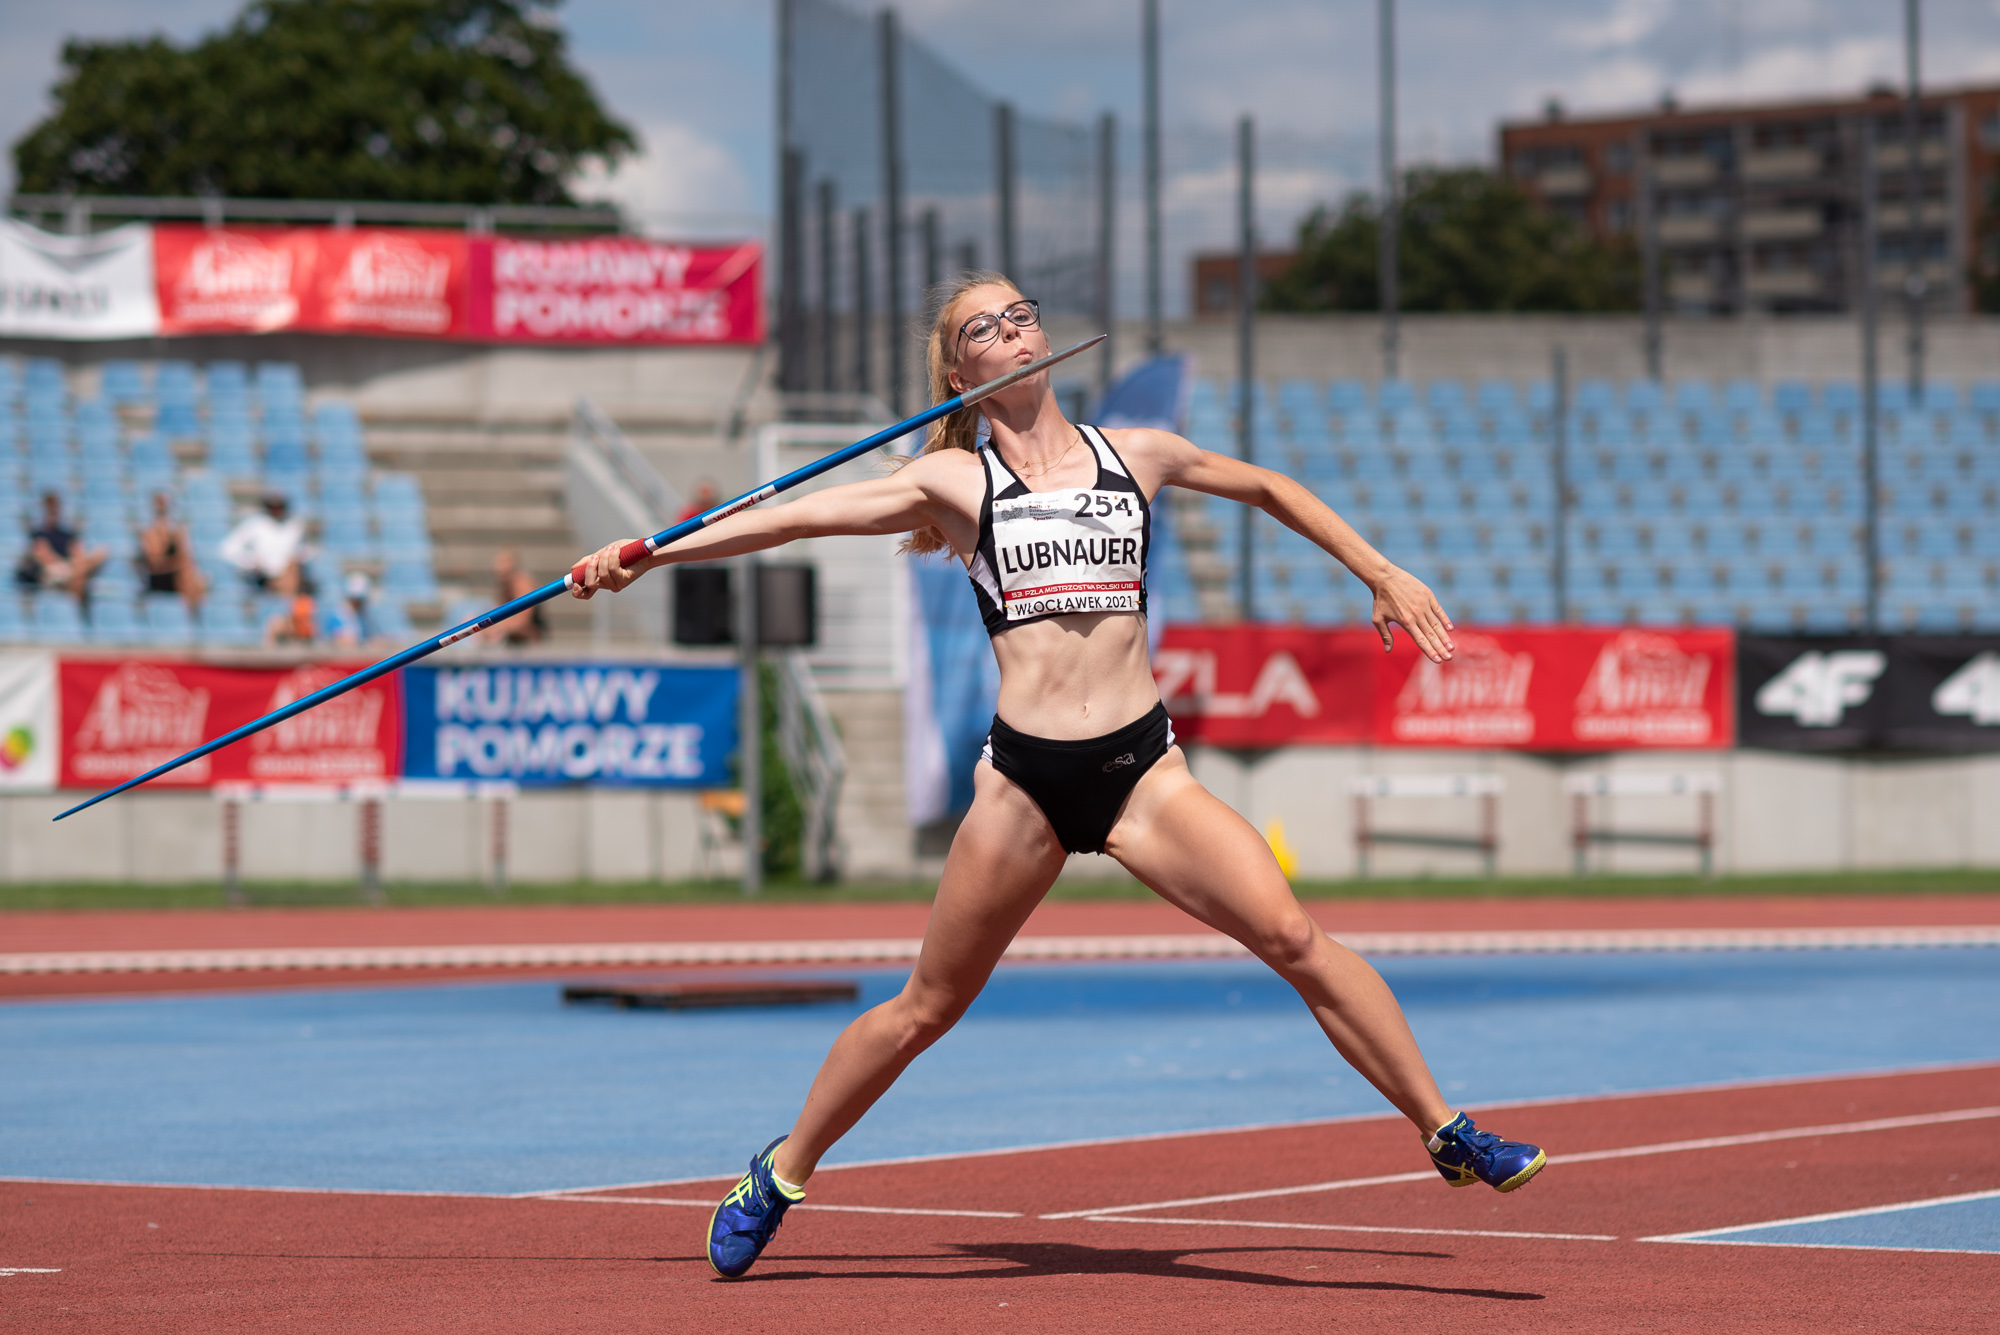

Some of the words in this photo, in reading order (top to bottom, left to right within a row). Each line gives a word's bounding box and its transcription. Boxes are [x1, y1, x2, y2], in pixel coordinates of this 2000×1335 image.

[493, 237, 693, 287] KUJAWY
[493, 288, 730, 337] POMORZE
[1074, 493, 1132, 517] 254
[1002, 538, 1137, 574] LUBNAUER
[1015, 596, 1102, 616] WŁOCŁAWEK
[1105, 595, 1133, 608] 2021
[1025, 589, 1044, 597] PZLA
[1044, 584, 1095, 594] MISTRZOSTWA
[435, 667, 658, 723] KUJAWY
[1153, 648, 1320, 718] ZLA
[1755, 650, 1888, 727] 4F
[1931, 650, 2000, 727] 4
[435, 723, 704, 778] POMORZE
